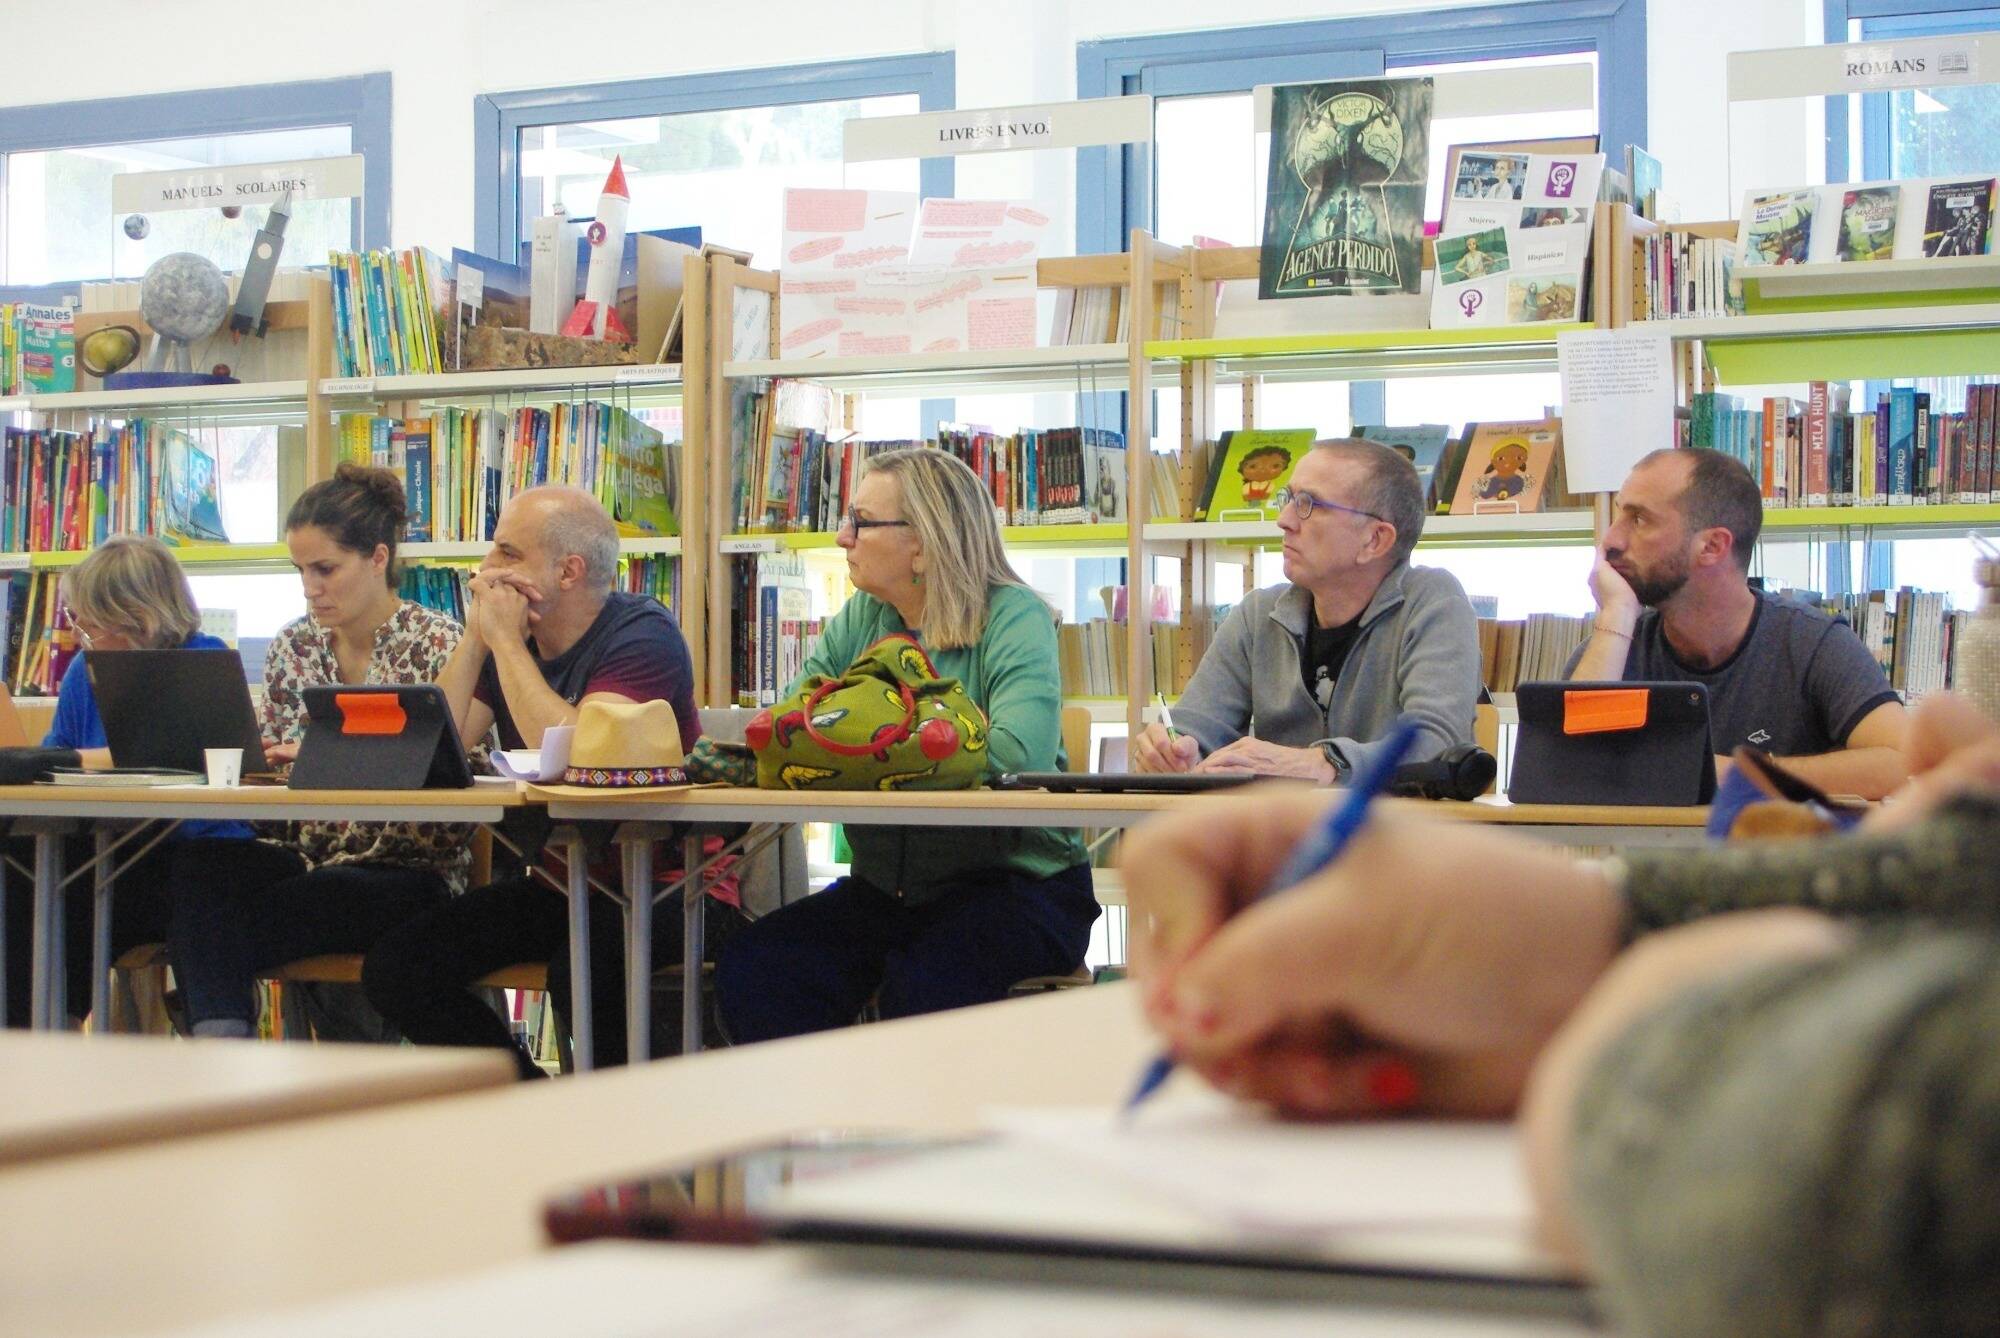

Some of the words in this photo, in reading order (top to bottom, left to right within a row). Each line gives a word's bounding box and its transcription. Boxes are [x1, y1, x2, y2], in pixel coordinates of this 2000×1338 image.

[1847, 58, 1926, 77] ROMANS
[939, 126, 993, 142] LIVRES
[997, 123, 1018, 137] EN
[1021, 121, 1050, 136] V.O.
[162, 184, 223, 201] MANUELS
[235, 178, 307, 196] SCOLAIRES
[1285, 239, 1337, 282] AGENCE
[1338, 238, 1394, 277] PERDIDO
[25, 305, 72, 321] Annales
[25, 336, 51, 349] Maths
[1811, 386, 1824, 416] HUNT
[1811, 419, 1824, 451] MILA
